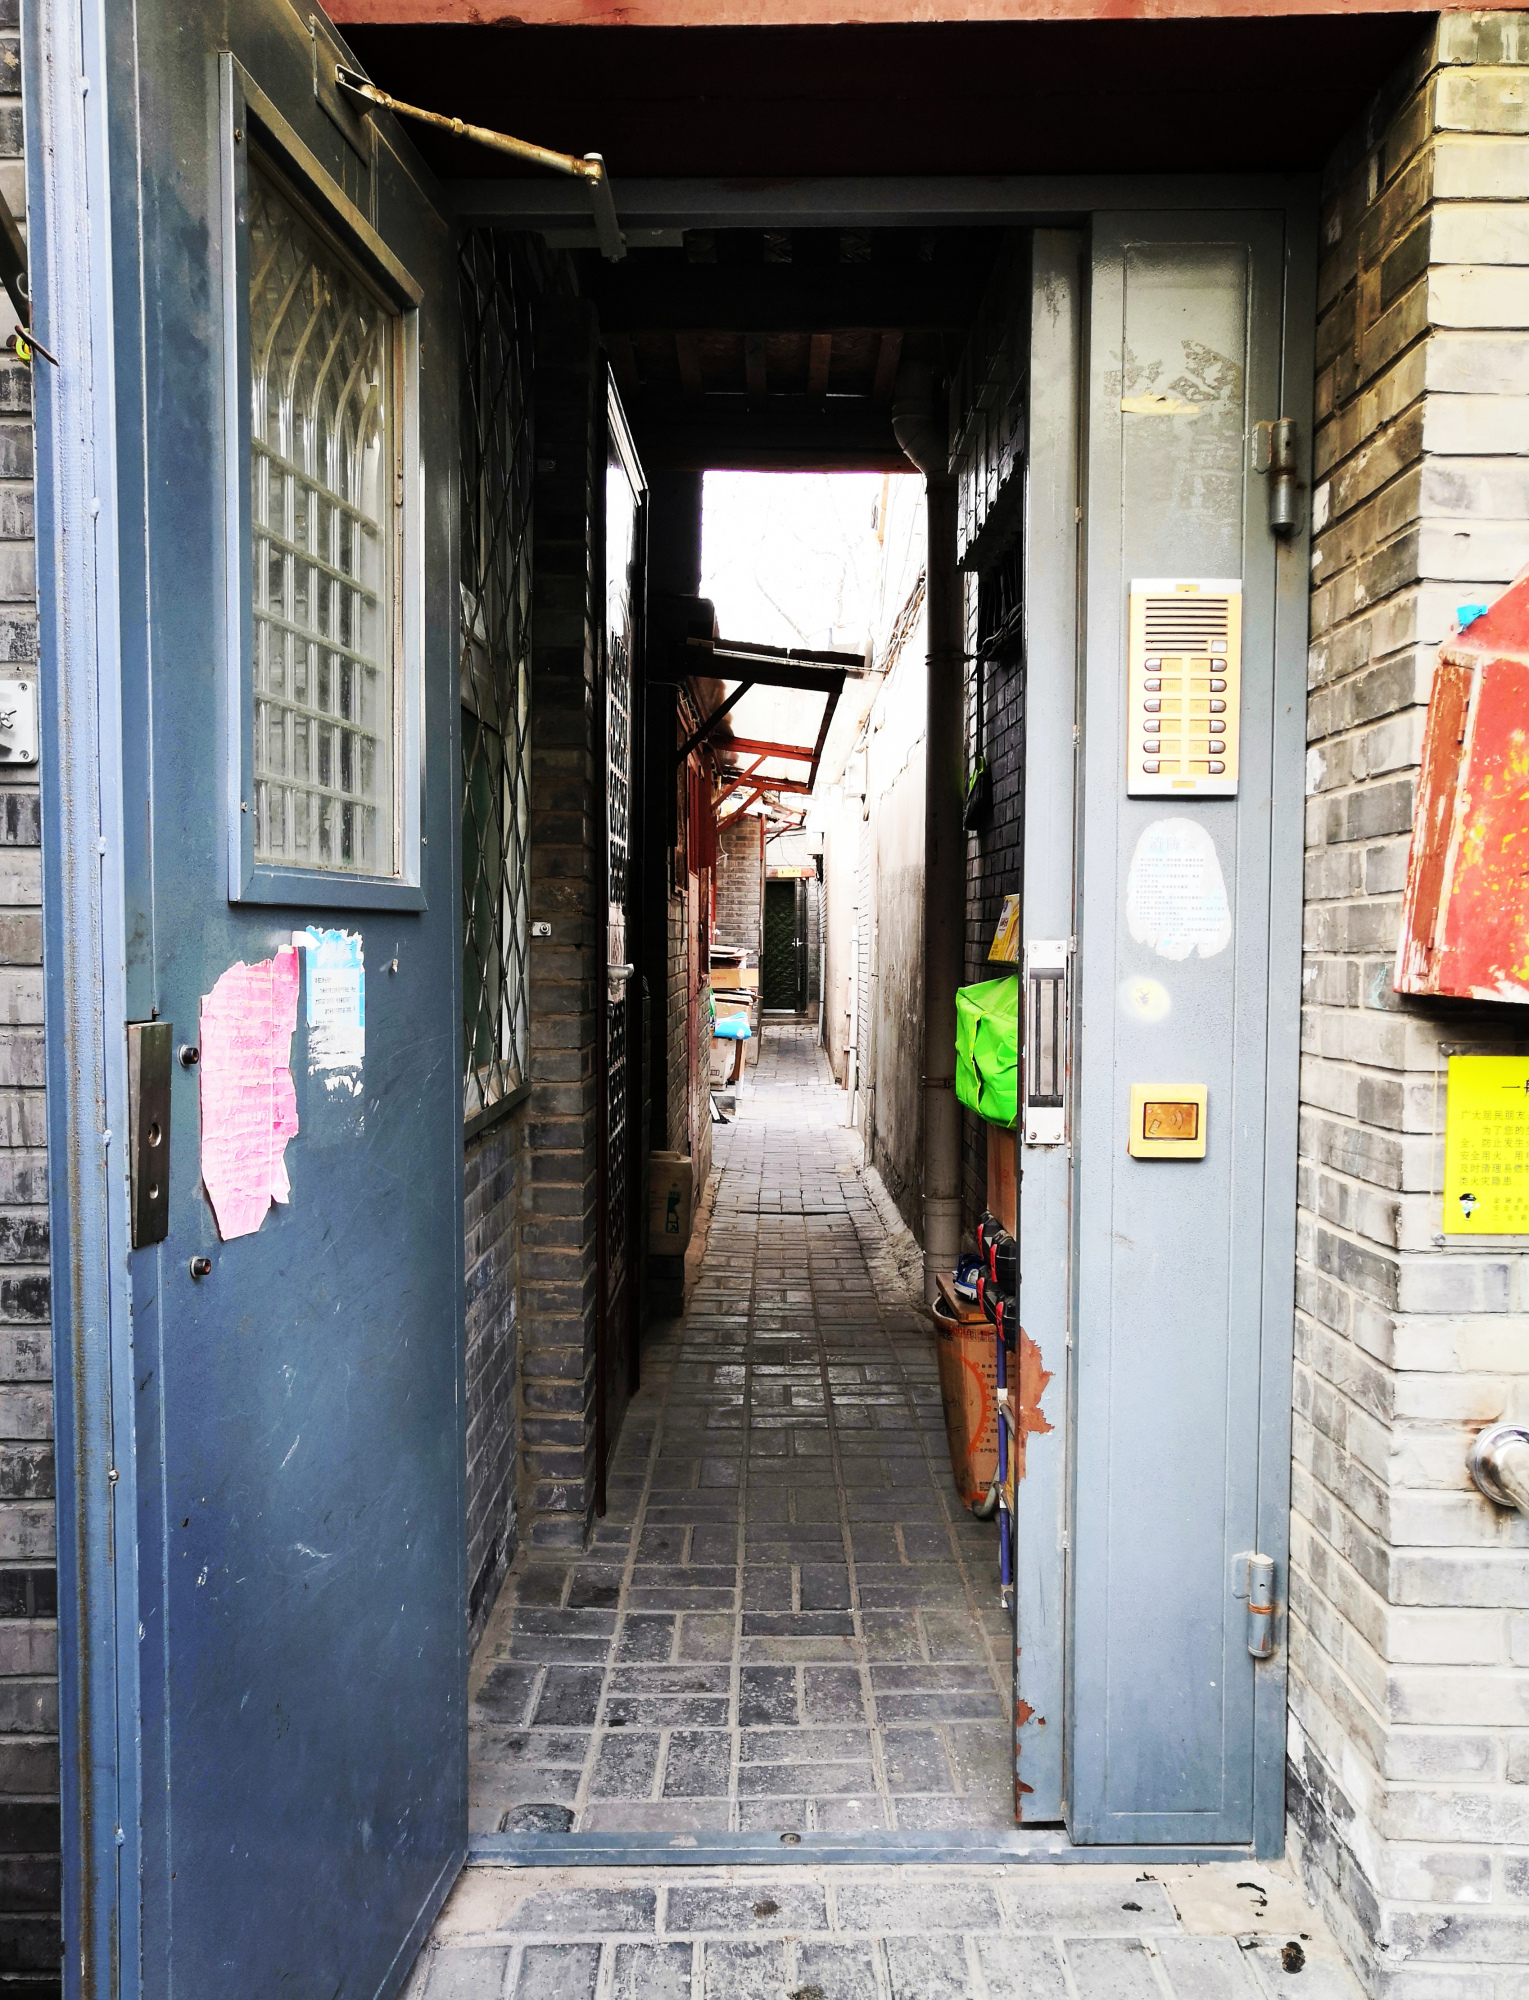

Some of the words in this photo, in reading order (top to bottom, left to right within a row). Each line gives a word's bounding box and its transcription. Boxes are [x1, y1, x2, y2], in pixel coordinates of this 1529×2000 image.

[1461, 1110, 1529, 1120] 广大居民朋友
